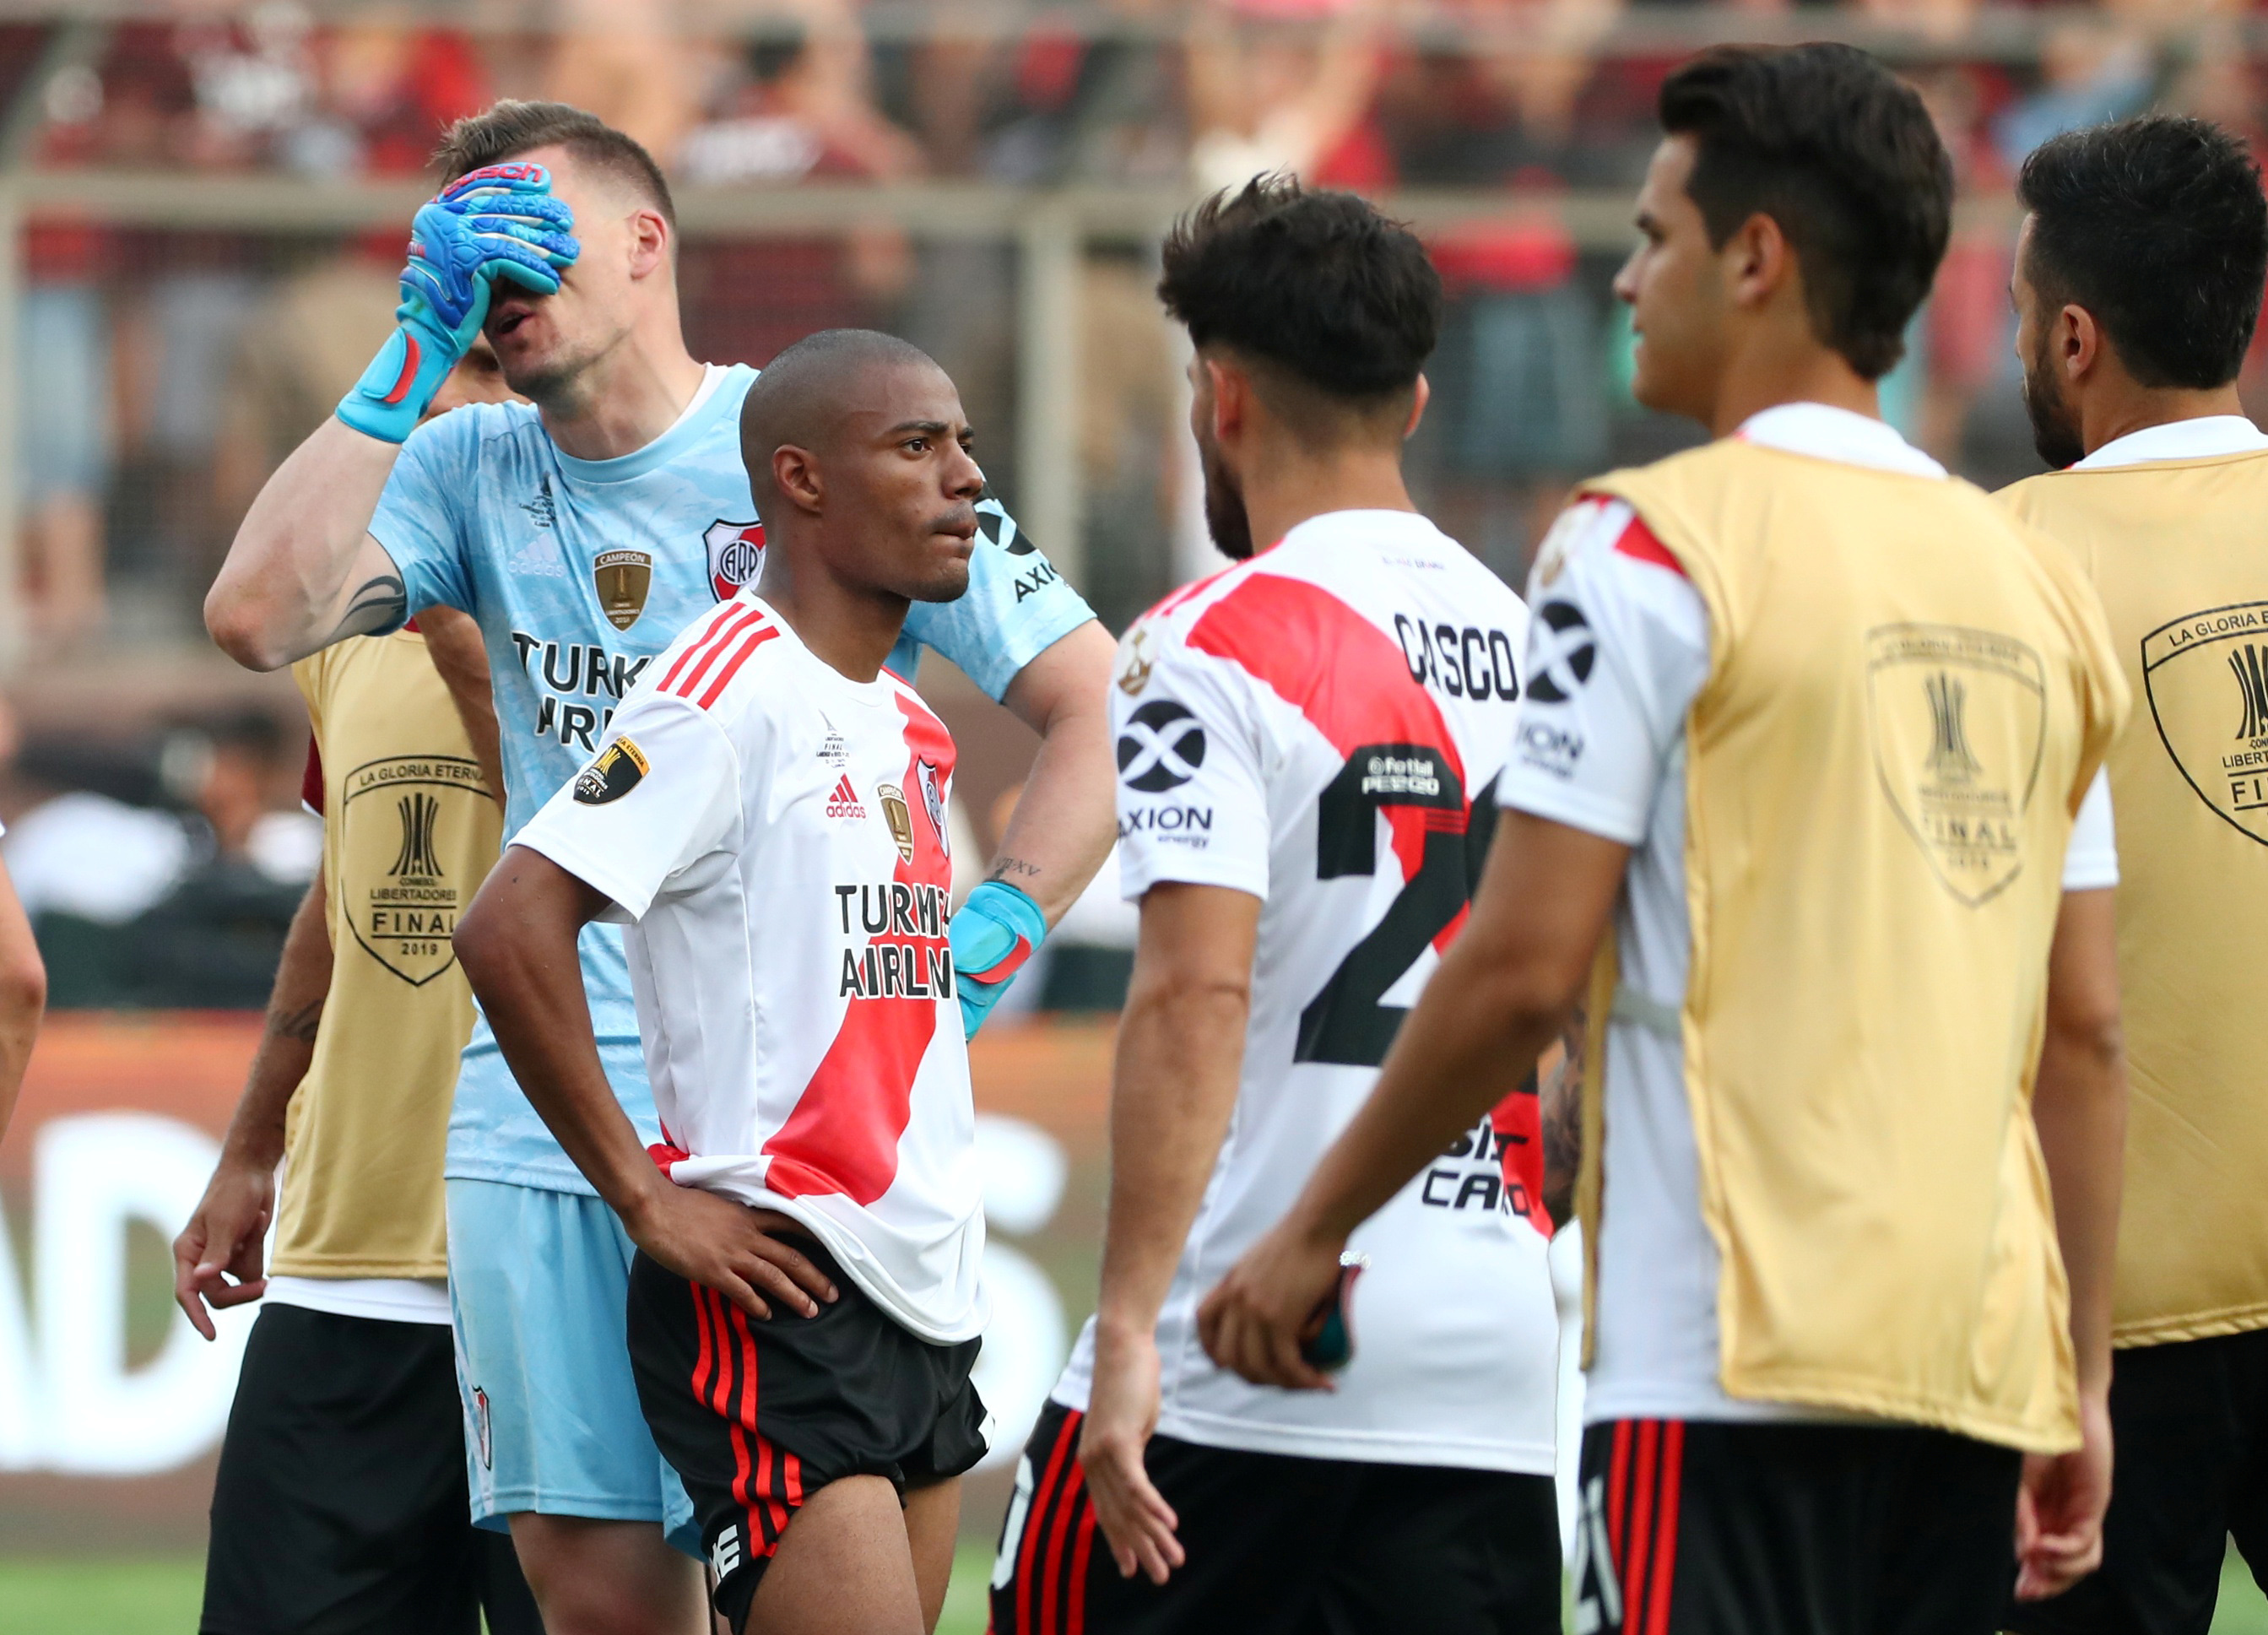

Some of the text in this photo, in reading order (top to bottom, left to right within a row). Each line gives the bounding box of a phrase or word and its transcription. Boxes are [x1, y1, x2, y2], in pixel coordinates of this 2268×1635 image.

[1015, 560, 1059, 604] AXI
[2168, 629, 2194, 647] LA
[2195, 613, 2259, 636] GLORIA
[1394, 613, 1519, 702] CASCO
[360, 772, 375, 787] LA
[380, 765, 430, 781] GLORIA
[825, 804, 866, 819] adidas
[401, 943, 438, 956] 2019
